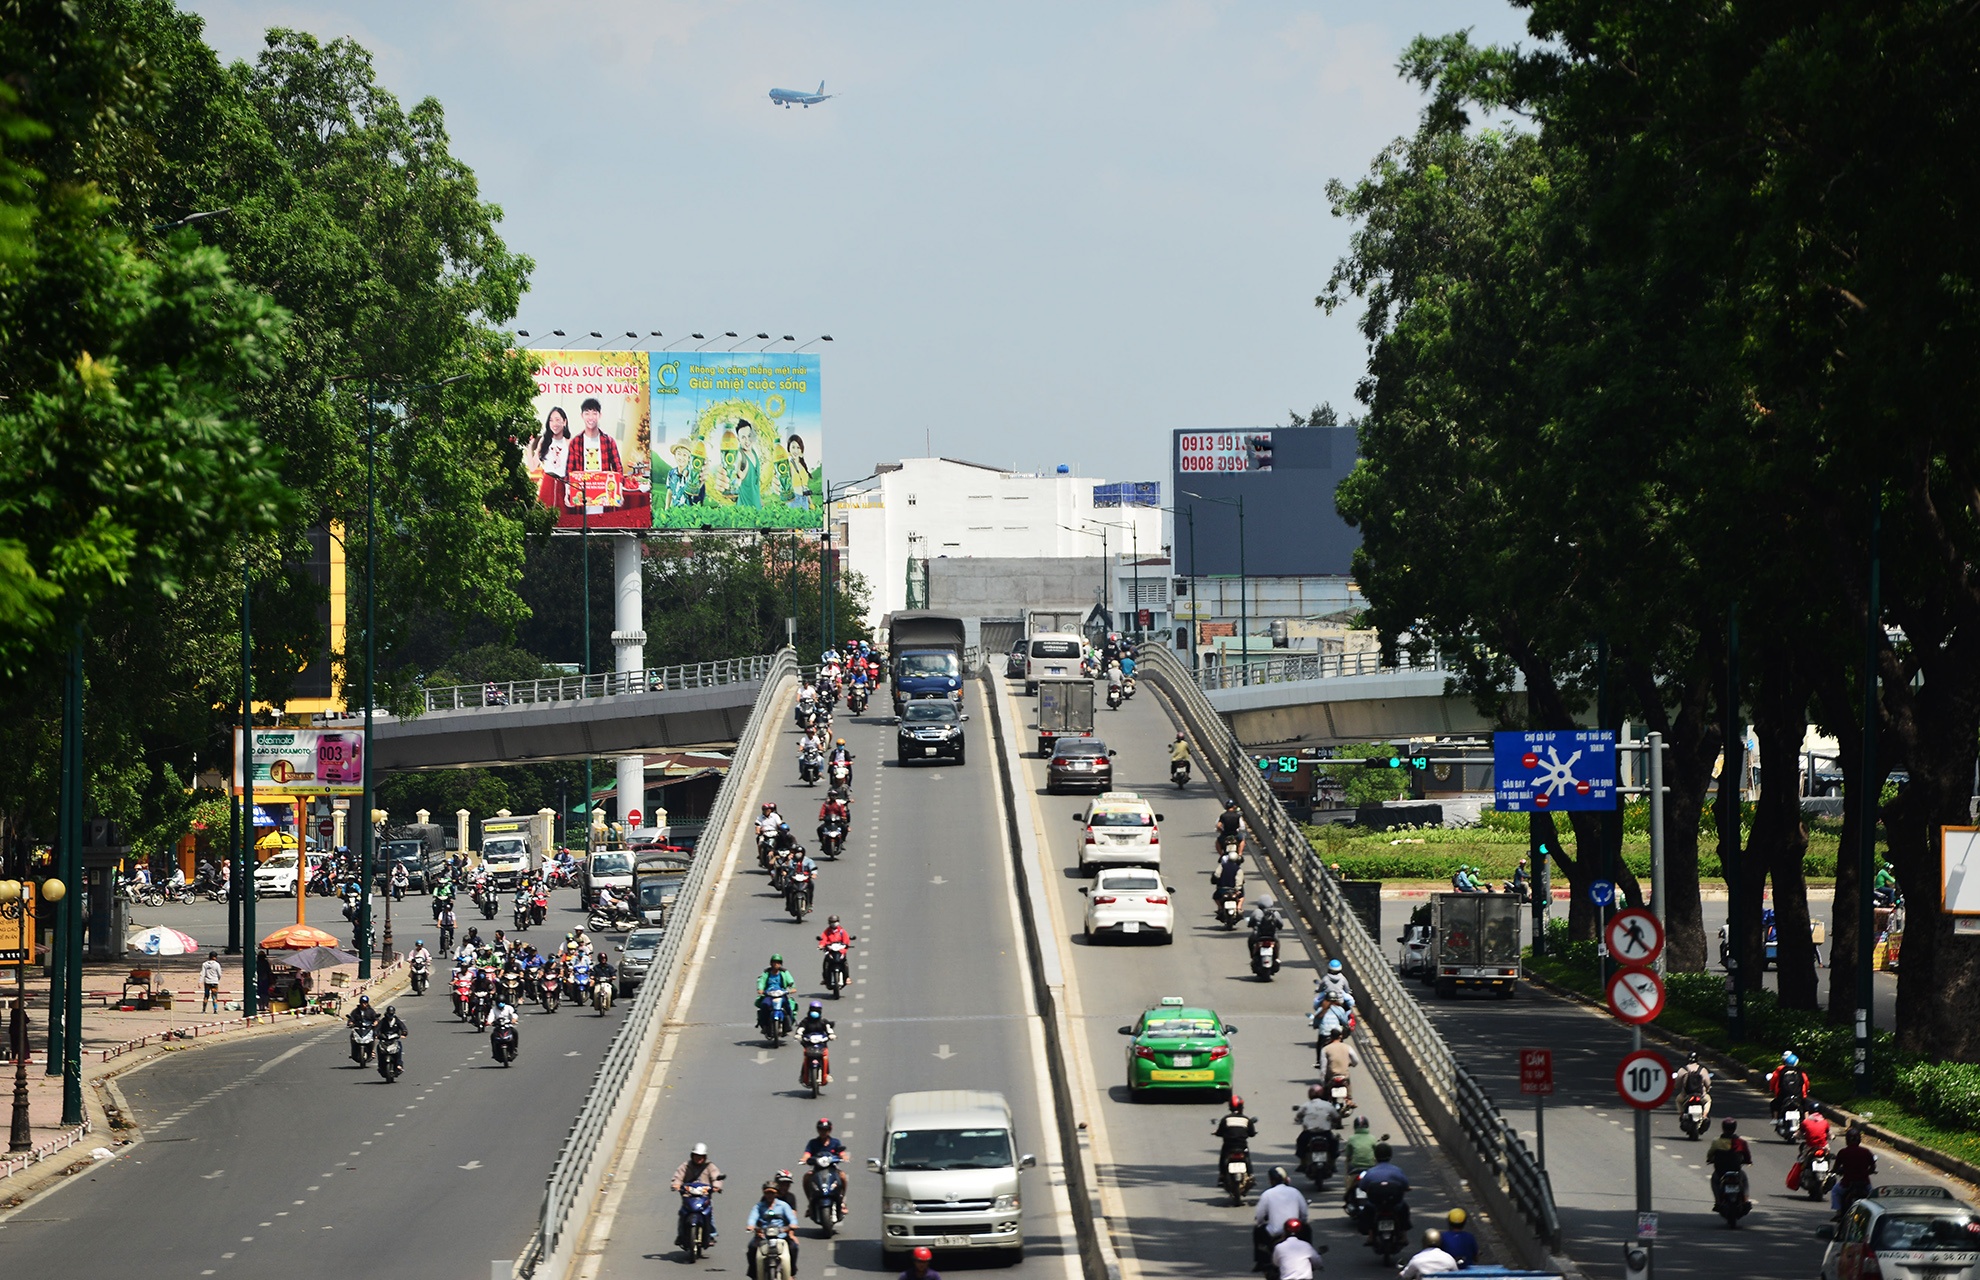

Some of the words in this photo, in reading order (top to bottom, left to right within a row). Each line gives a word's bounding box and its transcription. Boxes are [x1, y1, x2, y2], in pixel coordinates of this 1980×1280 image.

[554, 364, 579, 378] QUÀ
[582, 364, 604, 377] SỨC
[606, 363, 638, 377] KHỎE
[689, 365, 715, 377] Không
[726, 365, 748, 377] căng
[749, 363, 773, 377] thẳng
[774, 365, 790, 377] mệt
[554, 380, 573, 394] TRẺ
[576, 380, 603, 394] ĐÓN
[689, 377, 713, 389] Giải
[716, 377, 745, 392] nhiệt
[747, 378, 775, 392] cuộc
[779, 376, 806, 393] sống
[1181, 435, 1213, 451] 0913
[1181, 456, 1214, 471] 0908
[320, 746, 342, 761] 003
[1278, 756, 1298, 773] 50
[1411, 757, 1427, 770] 49
